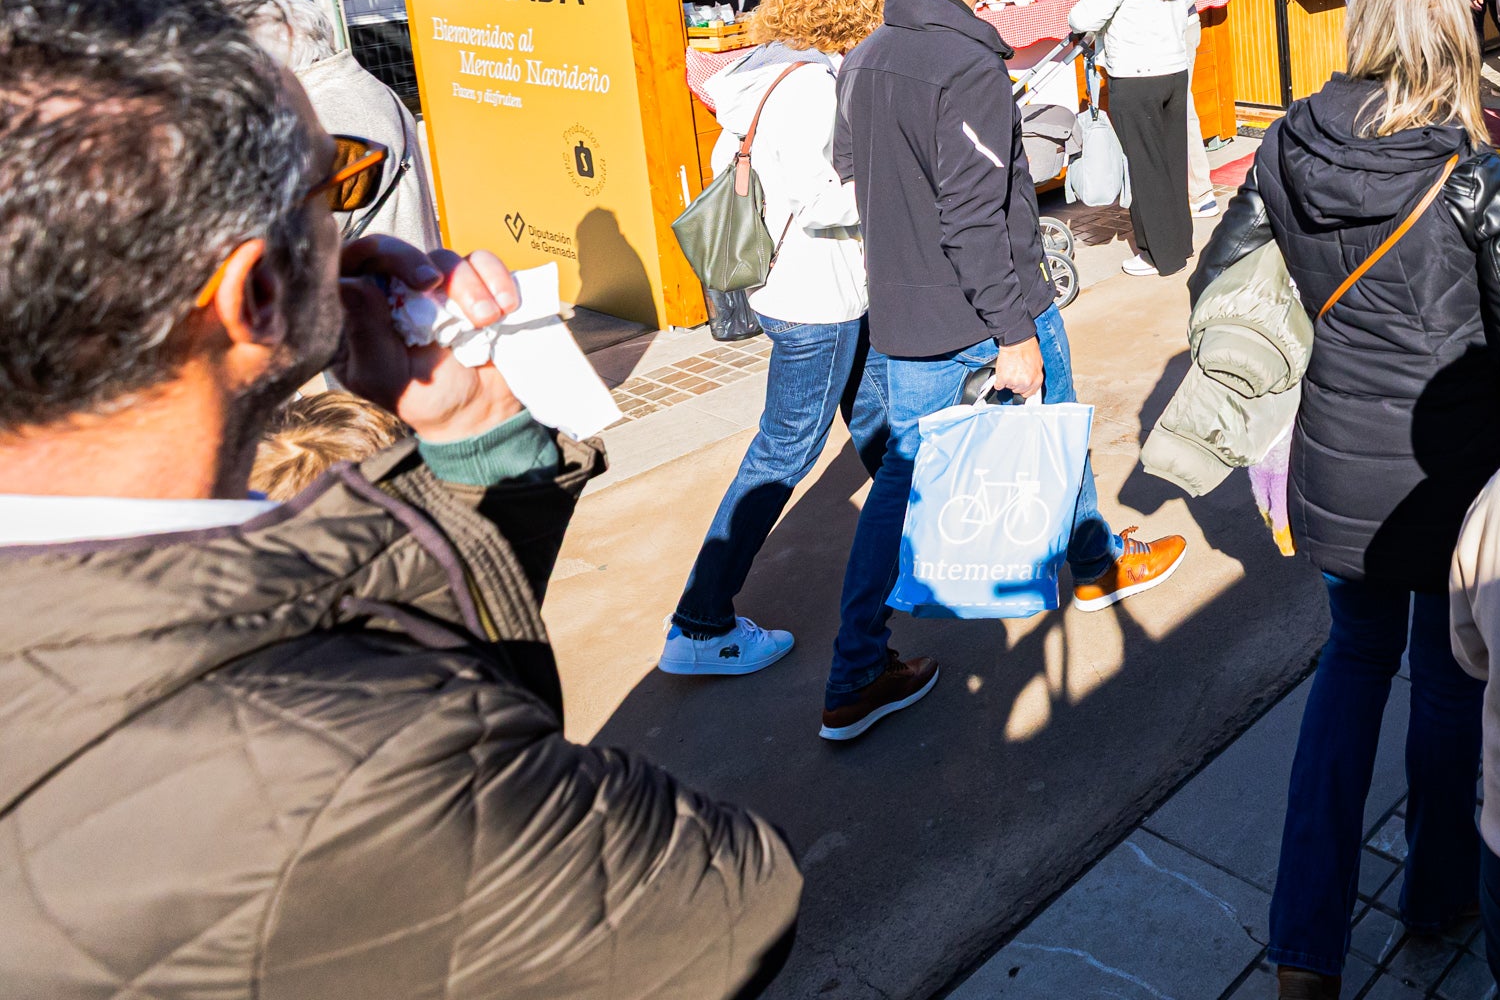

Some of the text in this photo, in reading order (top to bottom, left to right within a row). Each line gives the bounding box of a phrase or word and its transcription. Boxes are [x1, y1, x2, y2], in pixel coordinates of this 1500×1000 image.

[431, 16, 534, 52] Bienvenidos al
[459, 50, 610, 93] Mercado Navideño
[528, 224, 572, 245] Diputación
[531, 239, 577, 260] de Granada
